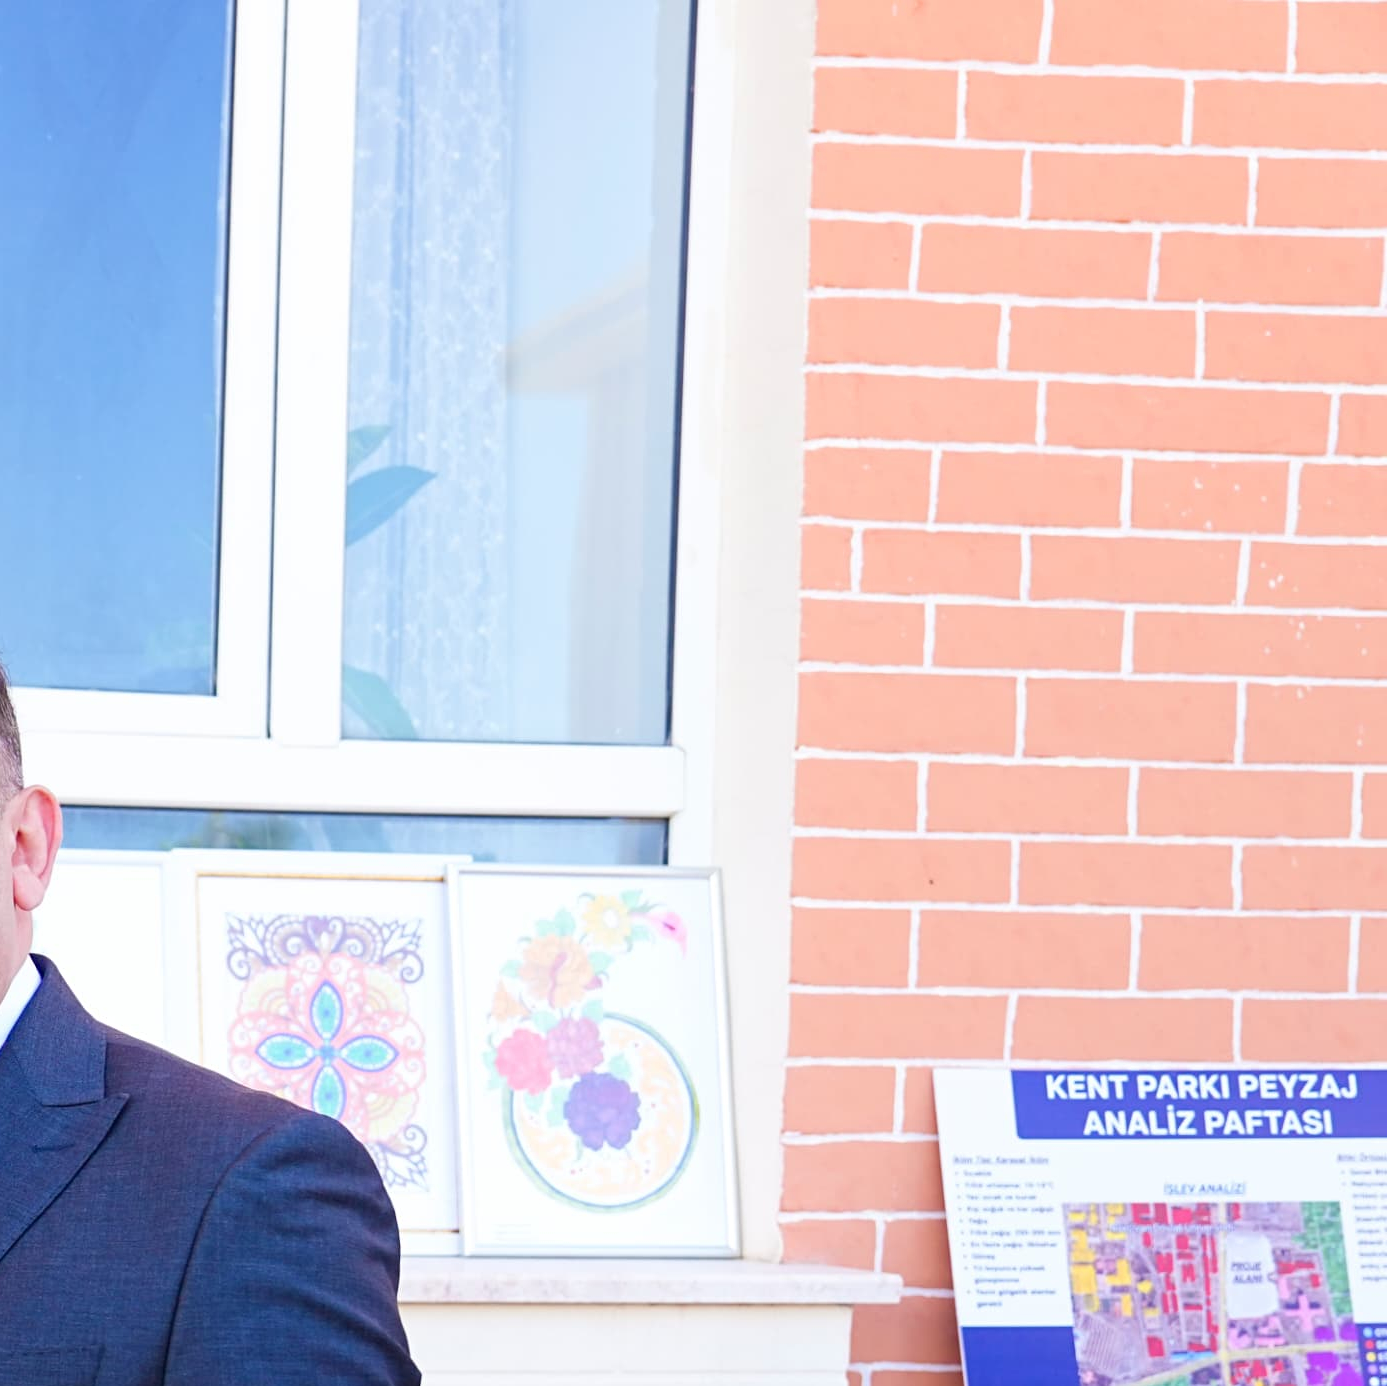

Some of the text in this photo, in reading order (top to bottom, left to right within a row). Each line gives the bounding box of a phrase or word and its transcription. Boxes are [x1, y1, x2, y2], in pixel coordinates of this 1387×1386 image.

[1046, 1074, 1358, 1100] KENT PARKI PEYZAJ
[1083, 1104, 1333, 1135] ANALİZ PAFTASI
